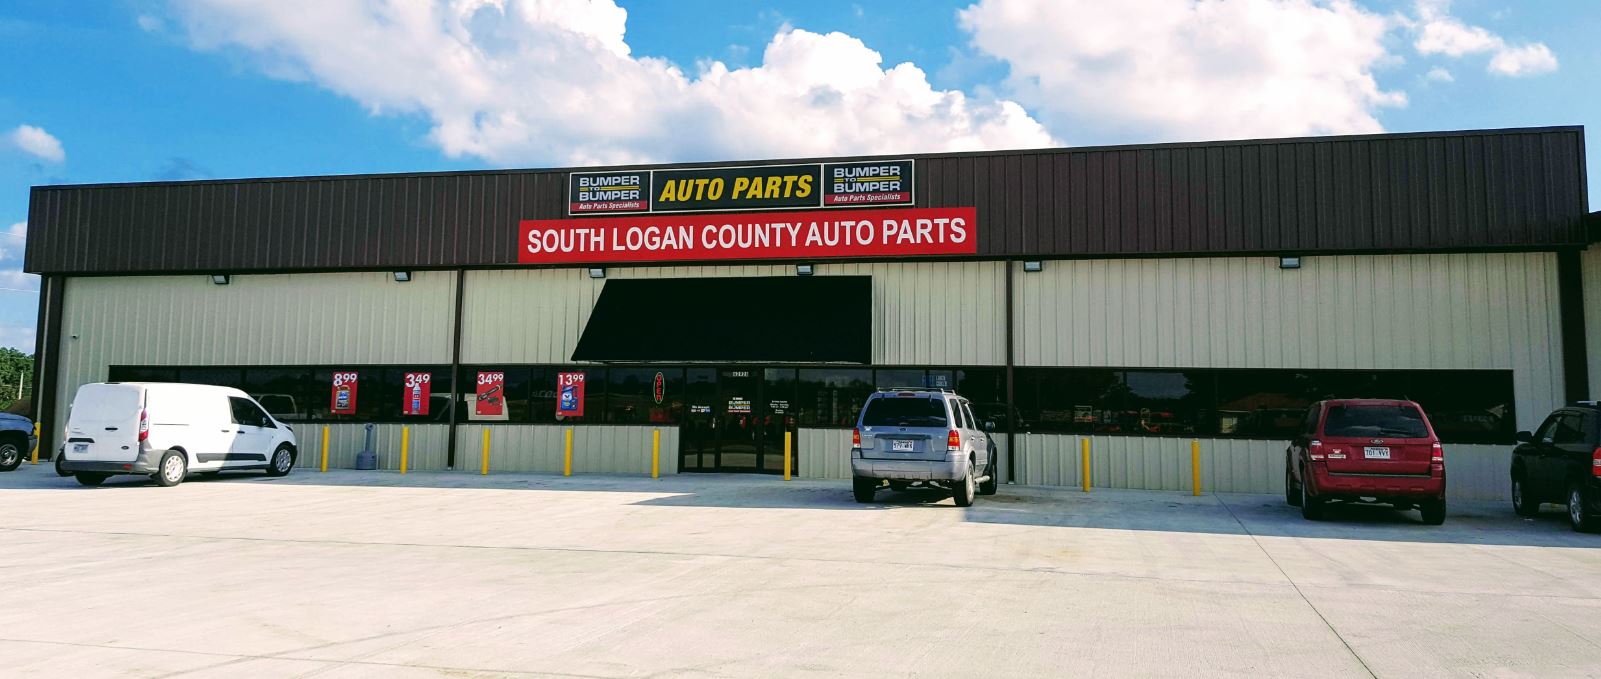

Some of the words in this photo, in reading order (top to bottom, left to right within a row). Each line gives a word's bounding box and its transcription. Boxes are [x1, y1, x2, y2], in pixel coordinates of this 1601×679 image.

[833, 166, 901, 178] BUMPER
[579, 176, 640, 187] BUMPER
[833, 181, 901, 193] BUMPER
[659, 178, 725, 202] AUTO
[731, 175, 813, 200] PARTS
[579, 190, 640, 201] BUMPER
[849, 194, 866, 202] Parts
[867, 193, 901, 202] Specialists
[608, 202, 640, 210] Specialists
[527, 229, 605, 253] SOUTH
[612, 226, 694, 250] LOGAN
[701, 222, 802, 249] COUNTY
[804, 219, 875, 247] AUTO
[882, 217, 967, 245] PARTS
